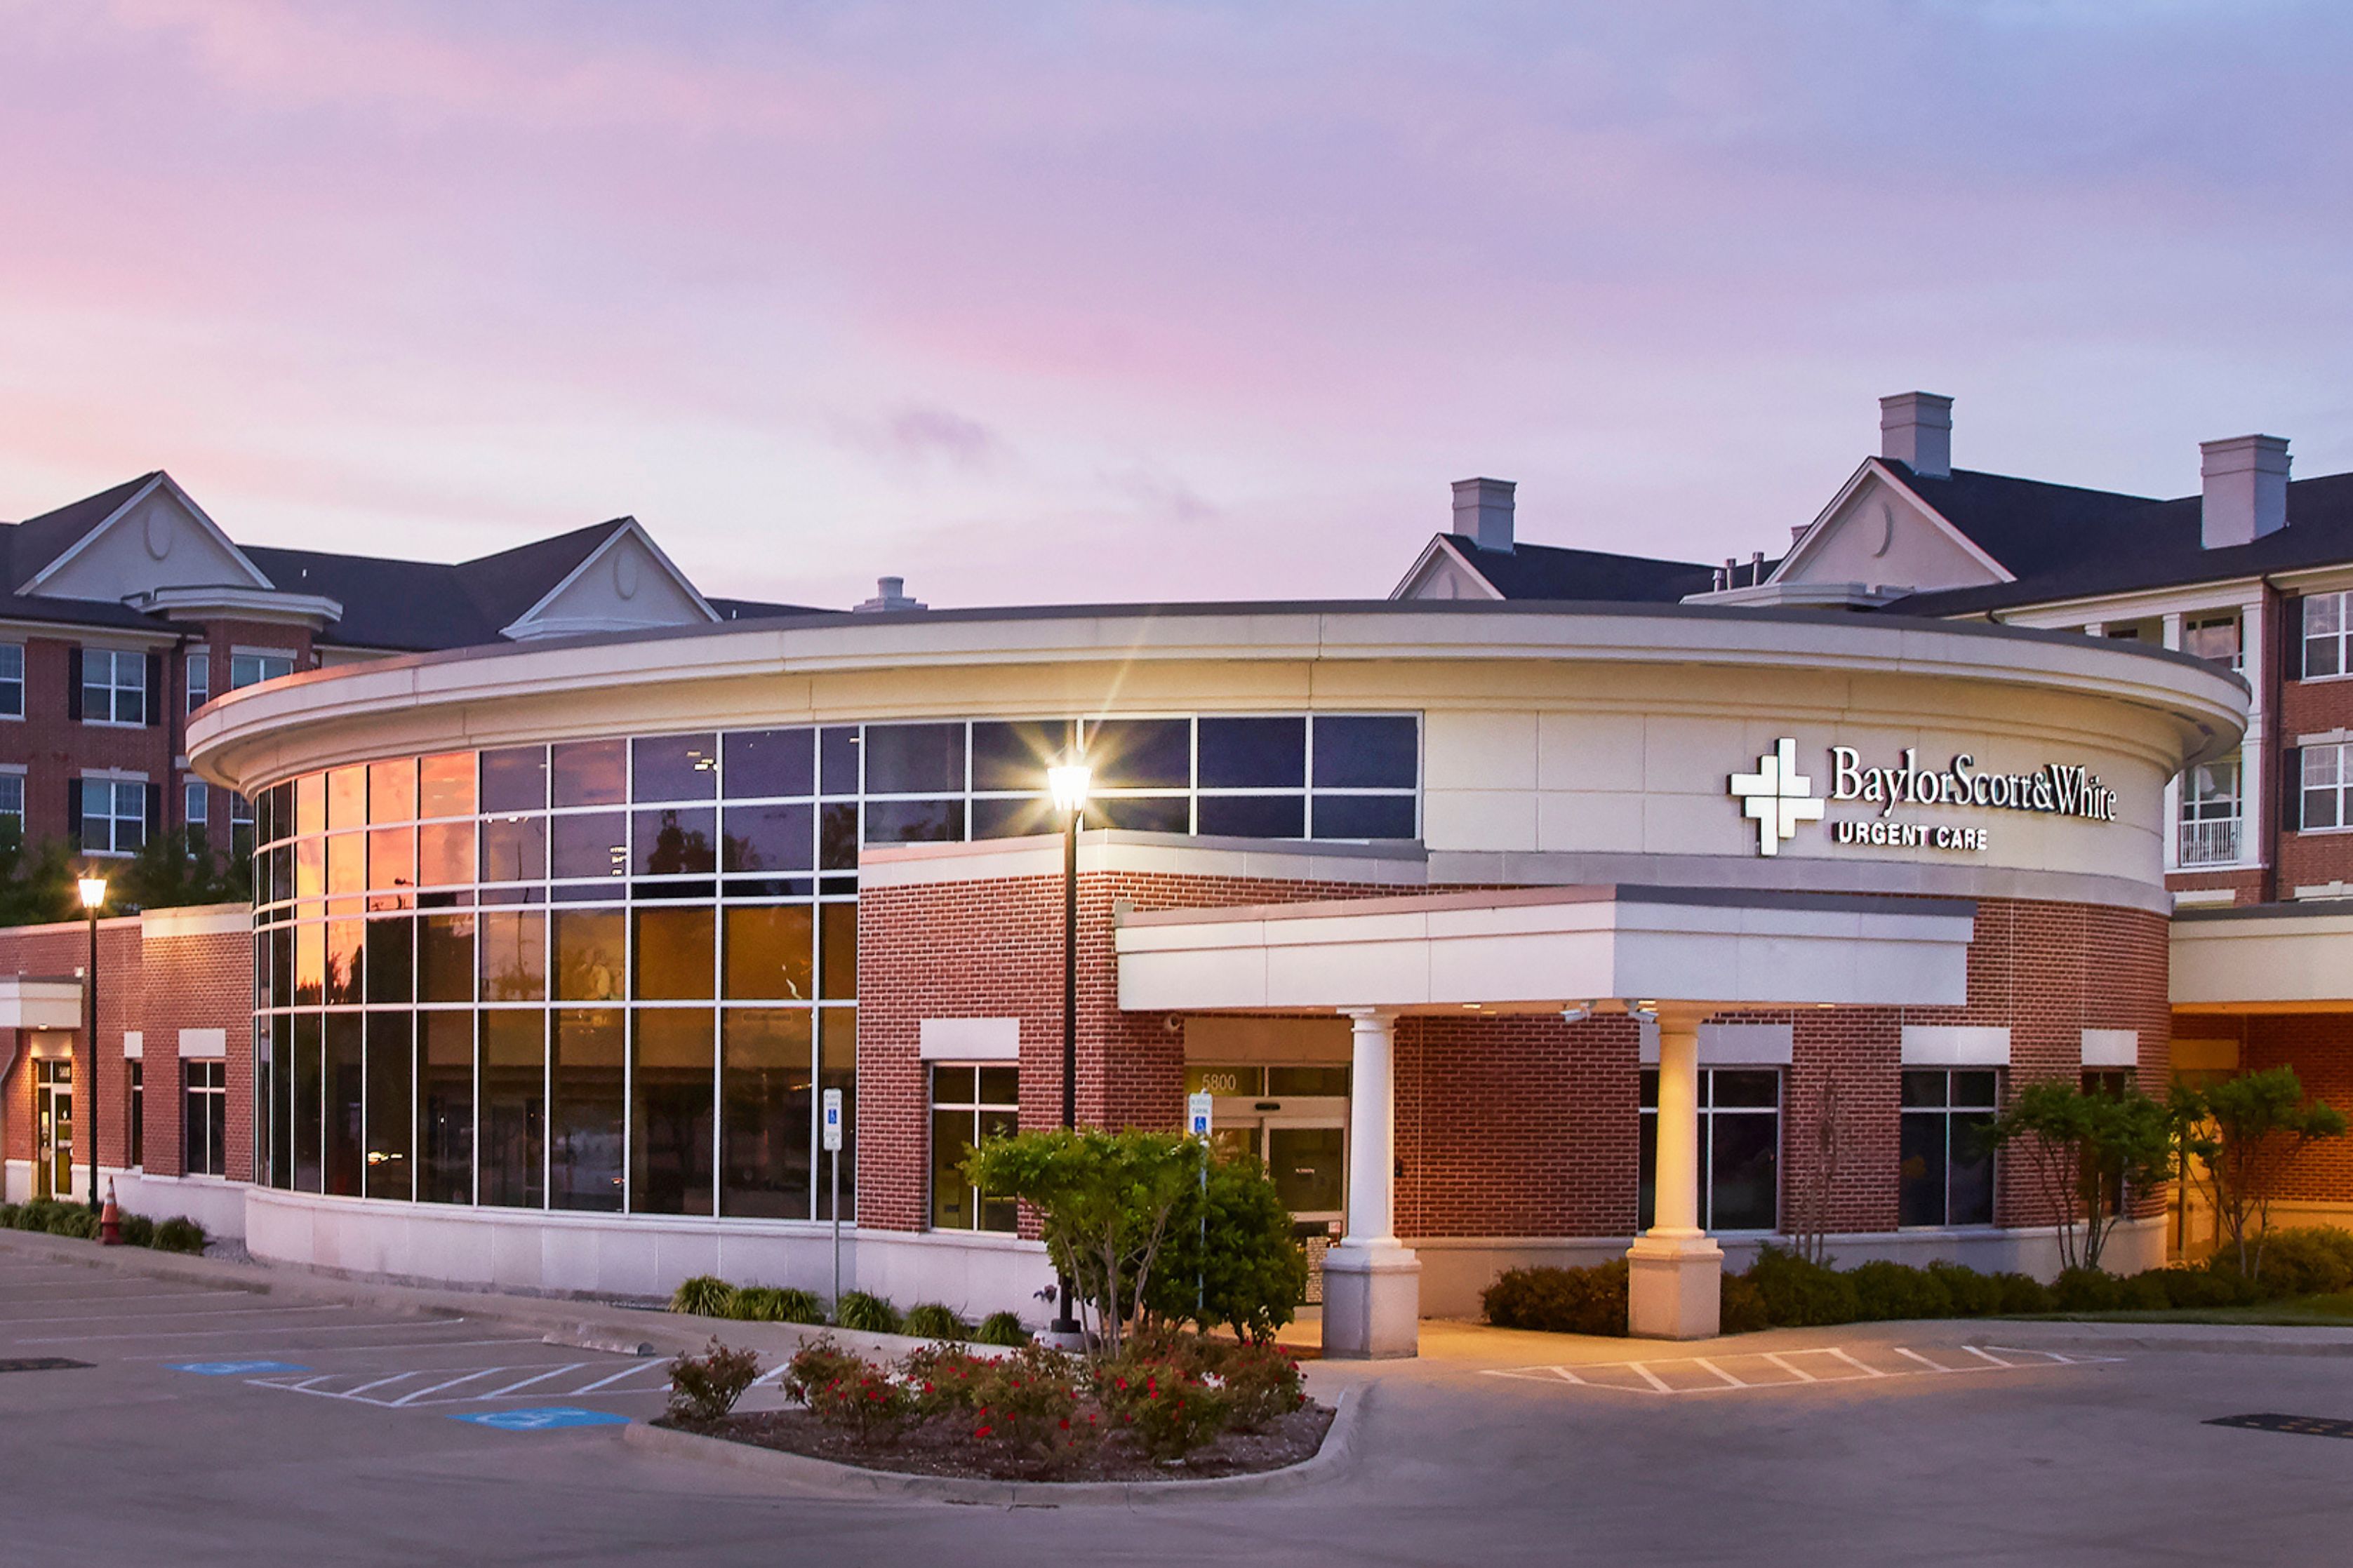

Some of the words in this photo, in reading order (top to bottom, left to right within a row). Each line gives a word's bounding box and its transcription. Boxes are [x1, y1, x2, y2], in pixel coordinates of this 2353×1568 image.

[1836, 819, 1930, 847] URGENT
[1935, 825, 1987, 851] CARE
[1202, 1073, 1237, 1091] 5800
